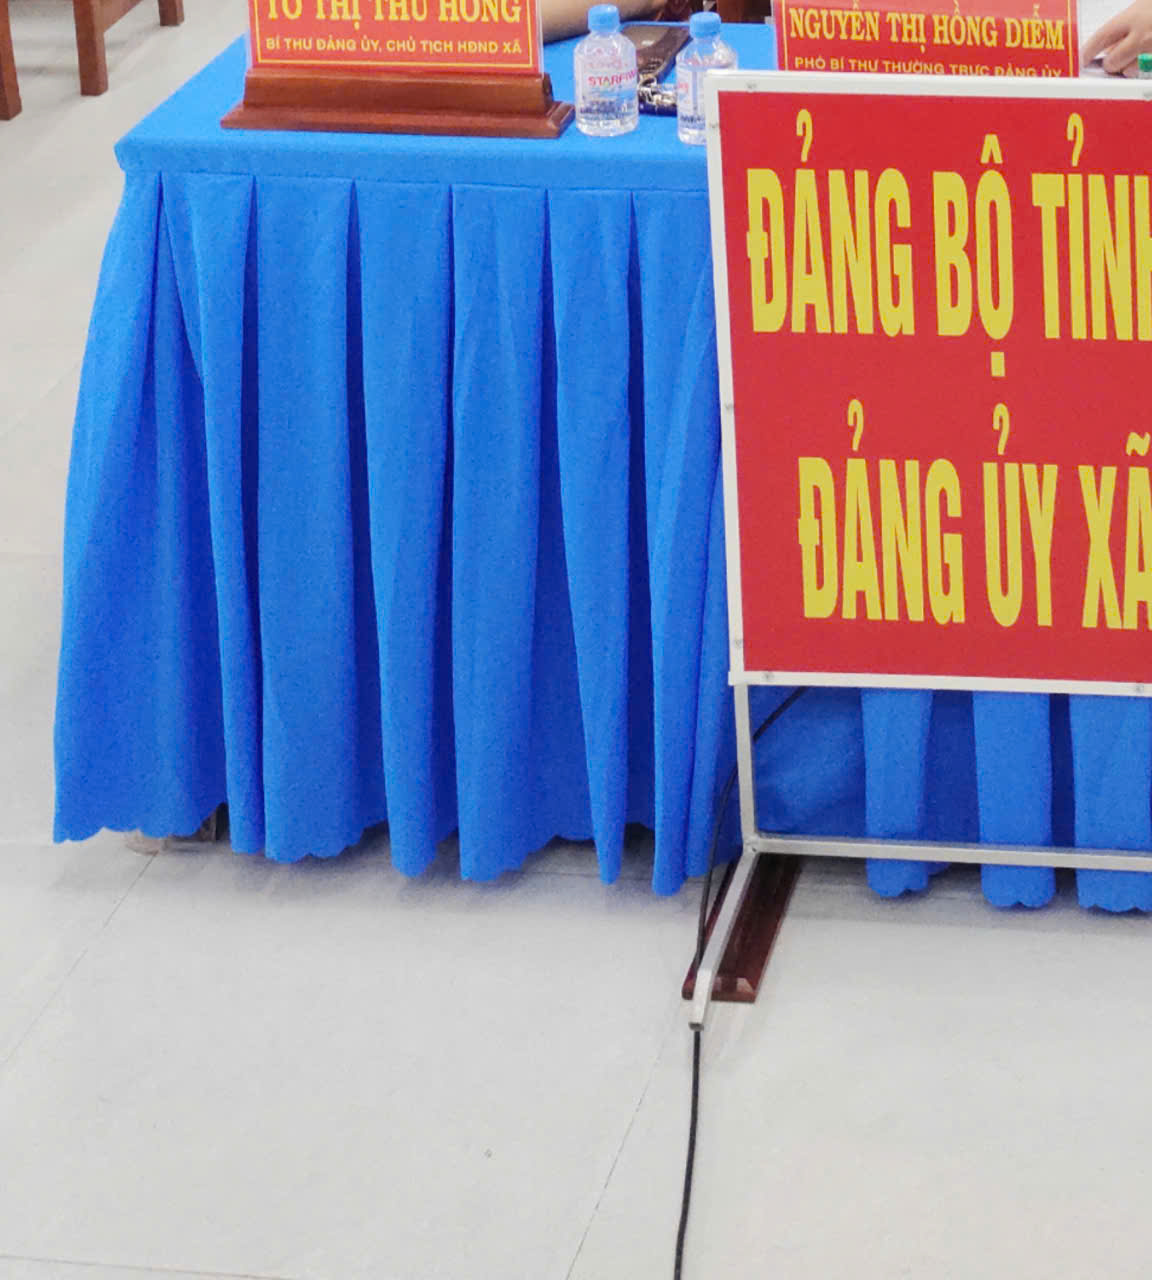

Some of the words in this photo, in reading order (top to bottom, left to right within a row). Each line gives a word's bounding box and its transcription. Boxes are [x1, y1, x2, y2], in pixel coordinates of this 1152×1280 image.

[265, 34, 280, 51] BÍ
[284, 36, 313, 51] THƯ
[316, 33, 357, 52] ĐẢNG
[360, 34, 382, 54] ỦY,
[386, 34, 417, 53] CHỦ
[420, 39, 453, 56] TỊCH
[457, 40, 499, 54] HĐND
[502, 38, 523, 55] XÃ
[886, 11, 927, 54] THỊ
[794, 51, 826, 70] PHÓ
[830, 56, 845, 71] BÍ
[848, 58, 879, 72] THƯ
[882, 57, 945, 75] THƯỜNG
[747, 110, 914, 336] ĐẢNG
[933, 135, 1013, 377] BỘ
[799, 399, 964, 625] ĐẢNG
[983, 404, 1057, 626] ỦY
